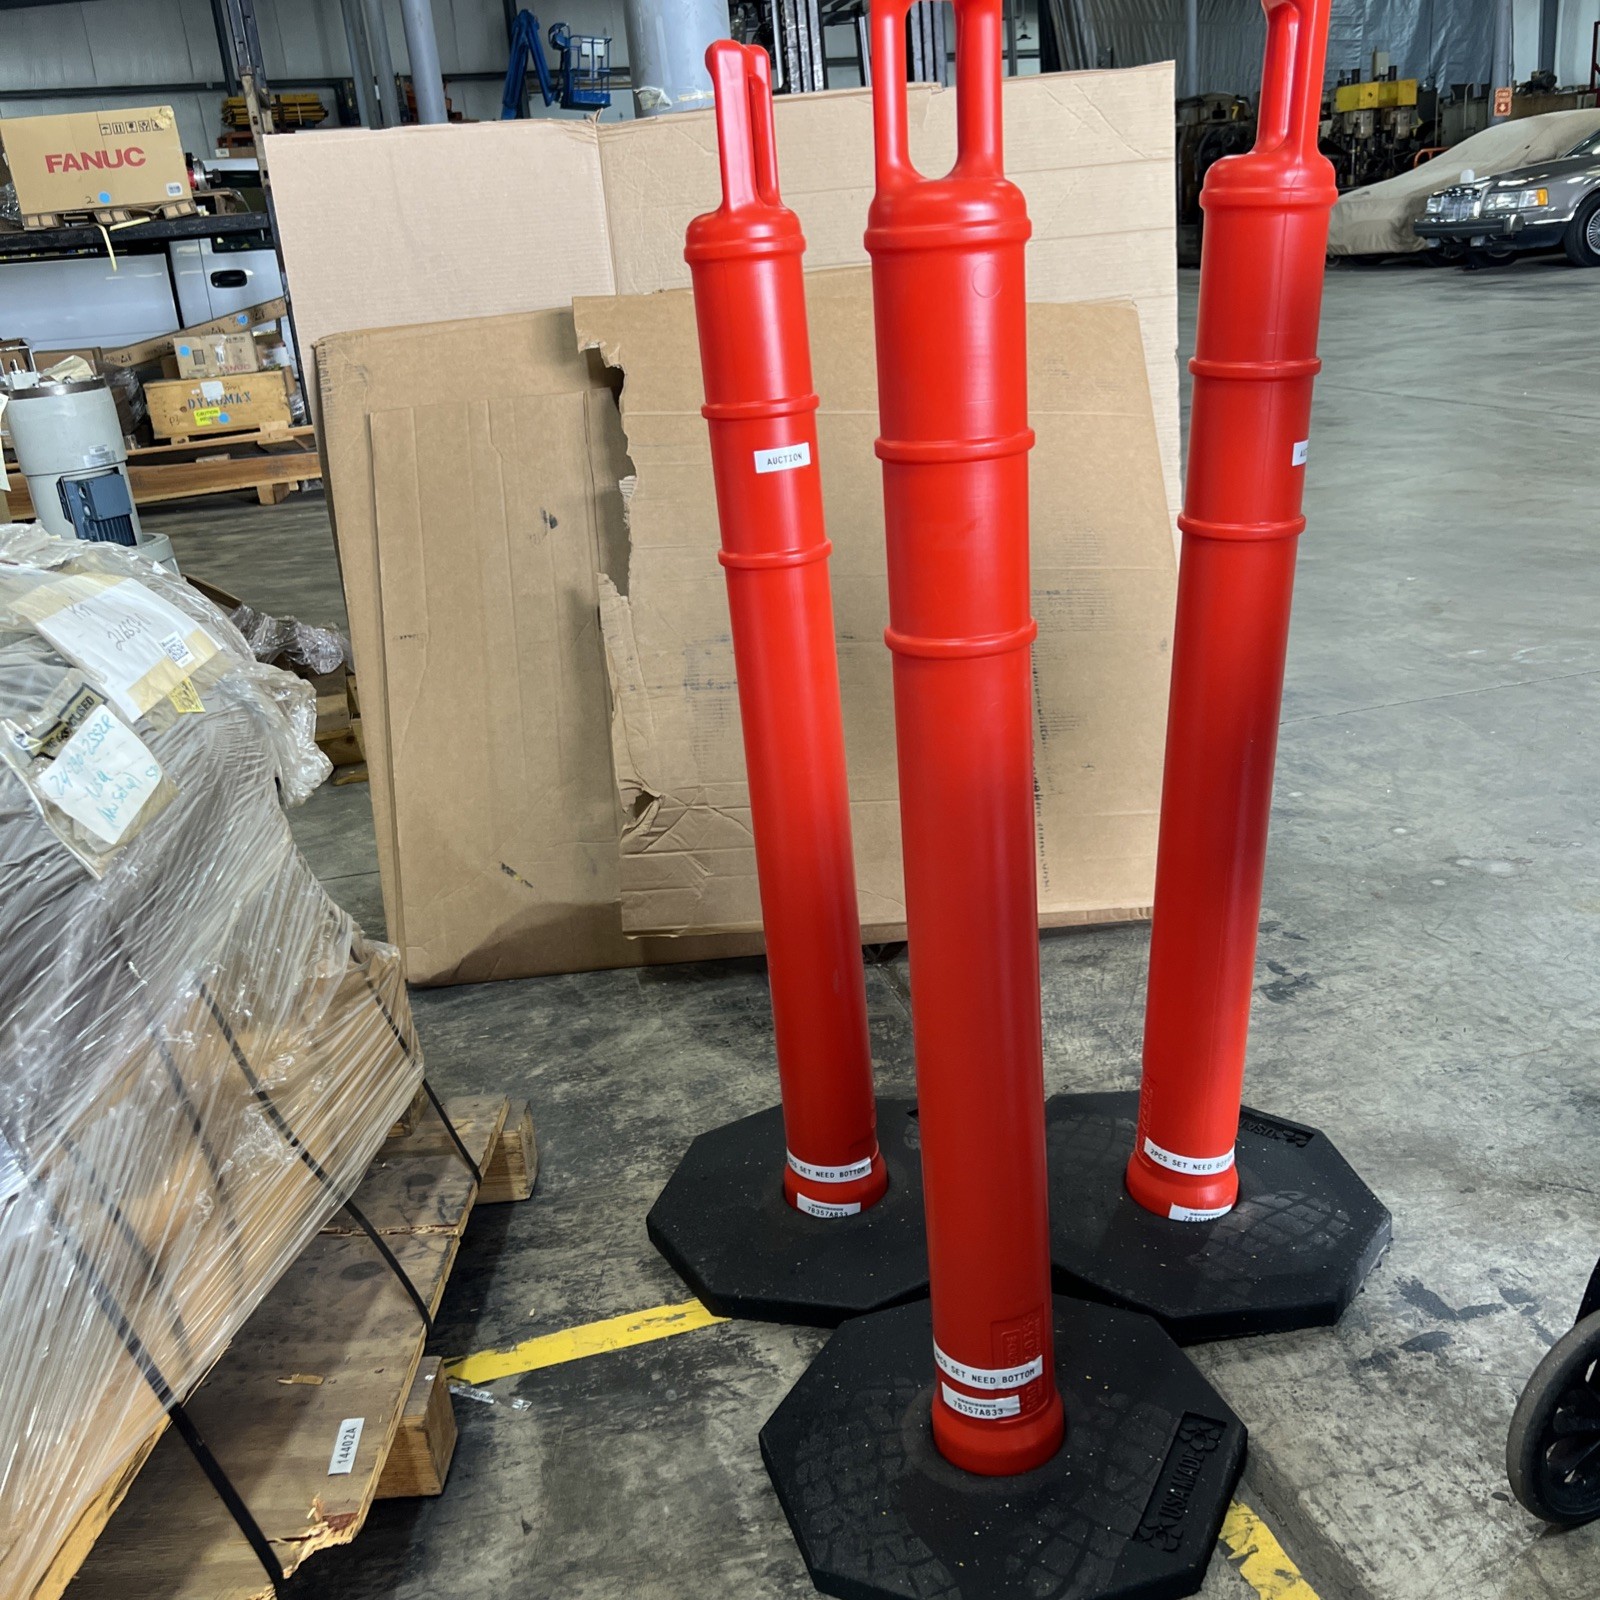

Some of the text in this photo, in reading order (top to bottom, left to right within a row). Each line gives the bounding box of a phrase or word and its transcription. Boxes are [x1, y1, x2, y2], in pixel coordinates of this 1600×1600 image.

[44, 147, 146, 174] FANUC
[767, 452, 803, 466] AUCTION
[1150, 1148, 1168, 1162] 2PCS
[1171, 1159, 1187, 1168] SET
[800, 1166, 811, 1175] SET
[815, 1171, 835, 1179] NEED
[839, 1166, 866, 1178] BOTTOM
[950, 1366, 966, 1378] SET
[971, 1374, 996, 1384] NEED
[1002, 1368, 1035, 1383] BOTTOM
[336, 1426, 357, 1464] 14402A
